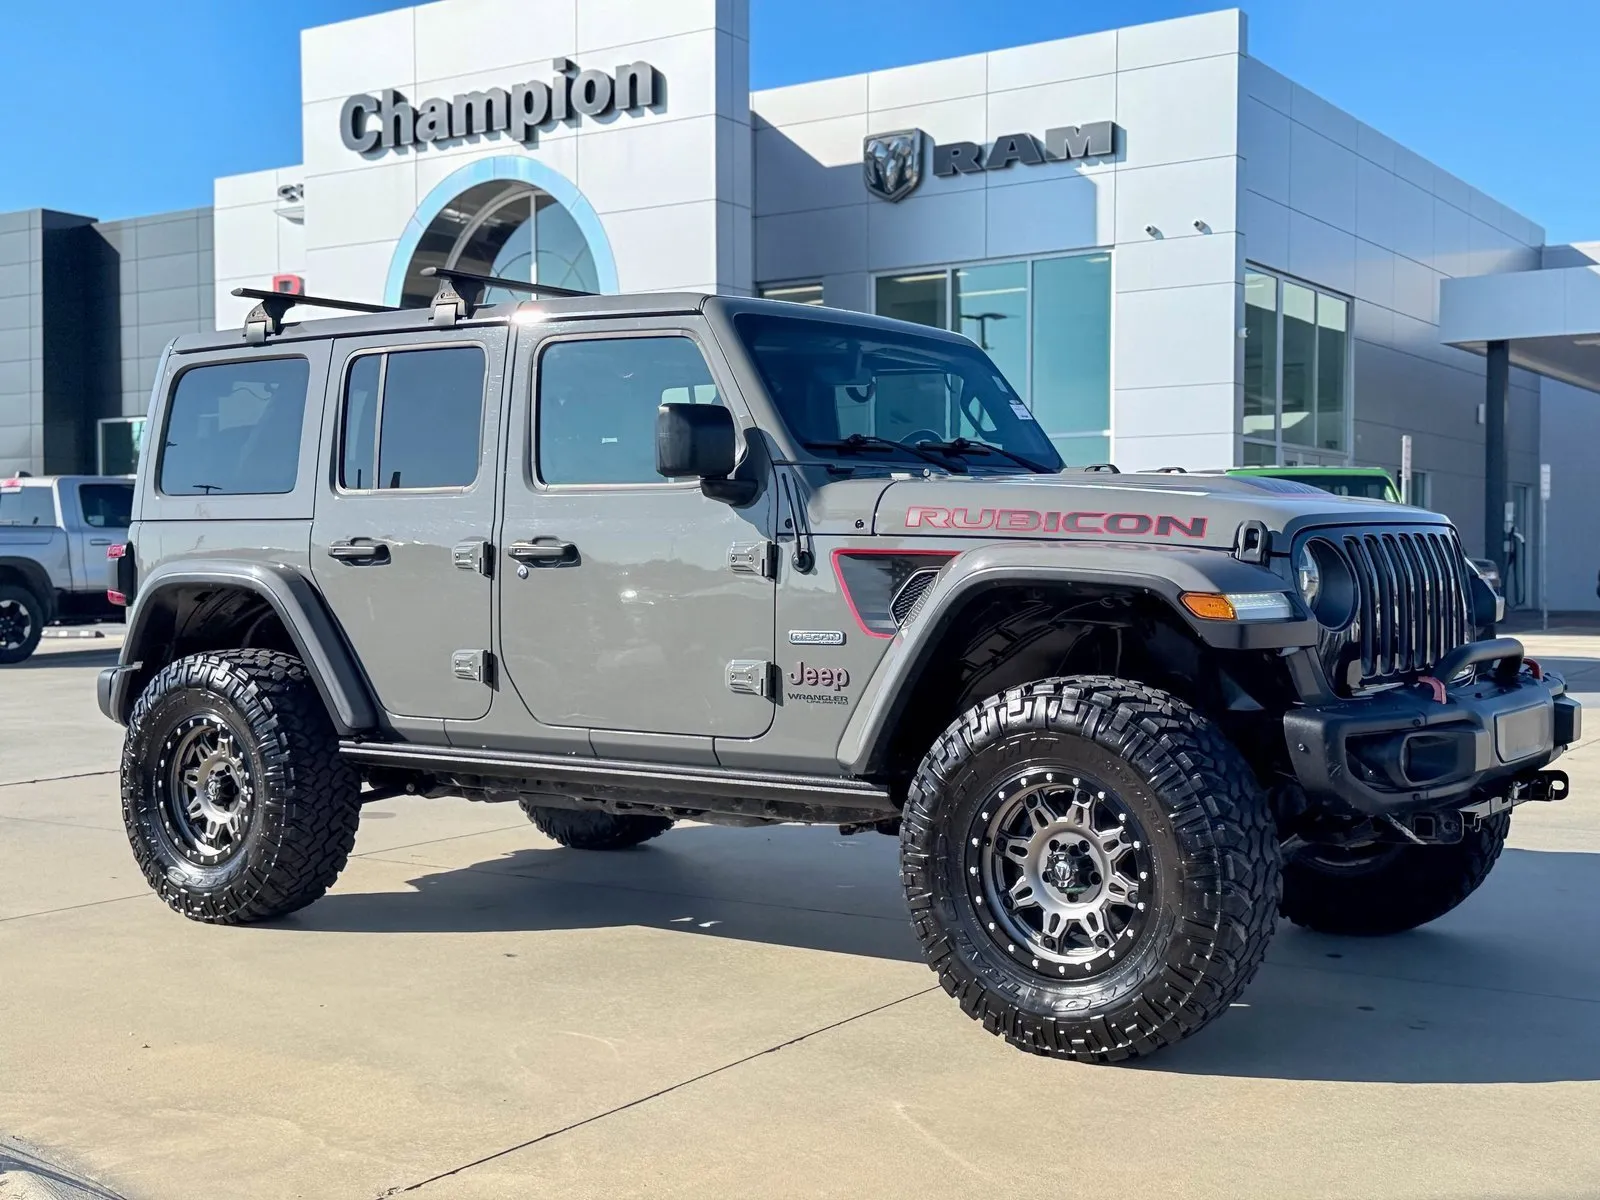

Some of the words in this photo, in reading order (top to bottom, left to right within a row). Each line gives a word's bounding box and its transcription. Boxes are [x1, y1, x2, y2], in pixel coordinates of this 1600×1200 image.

[339, 57, 659, 154] Champion
[932, 121, 1117, 178] RAM
[904, 506, 1209, 538] RUBICON
[787, 661, 850, 692] Jeep
[787, 693, 849, 702] WRANGLER
